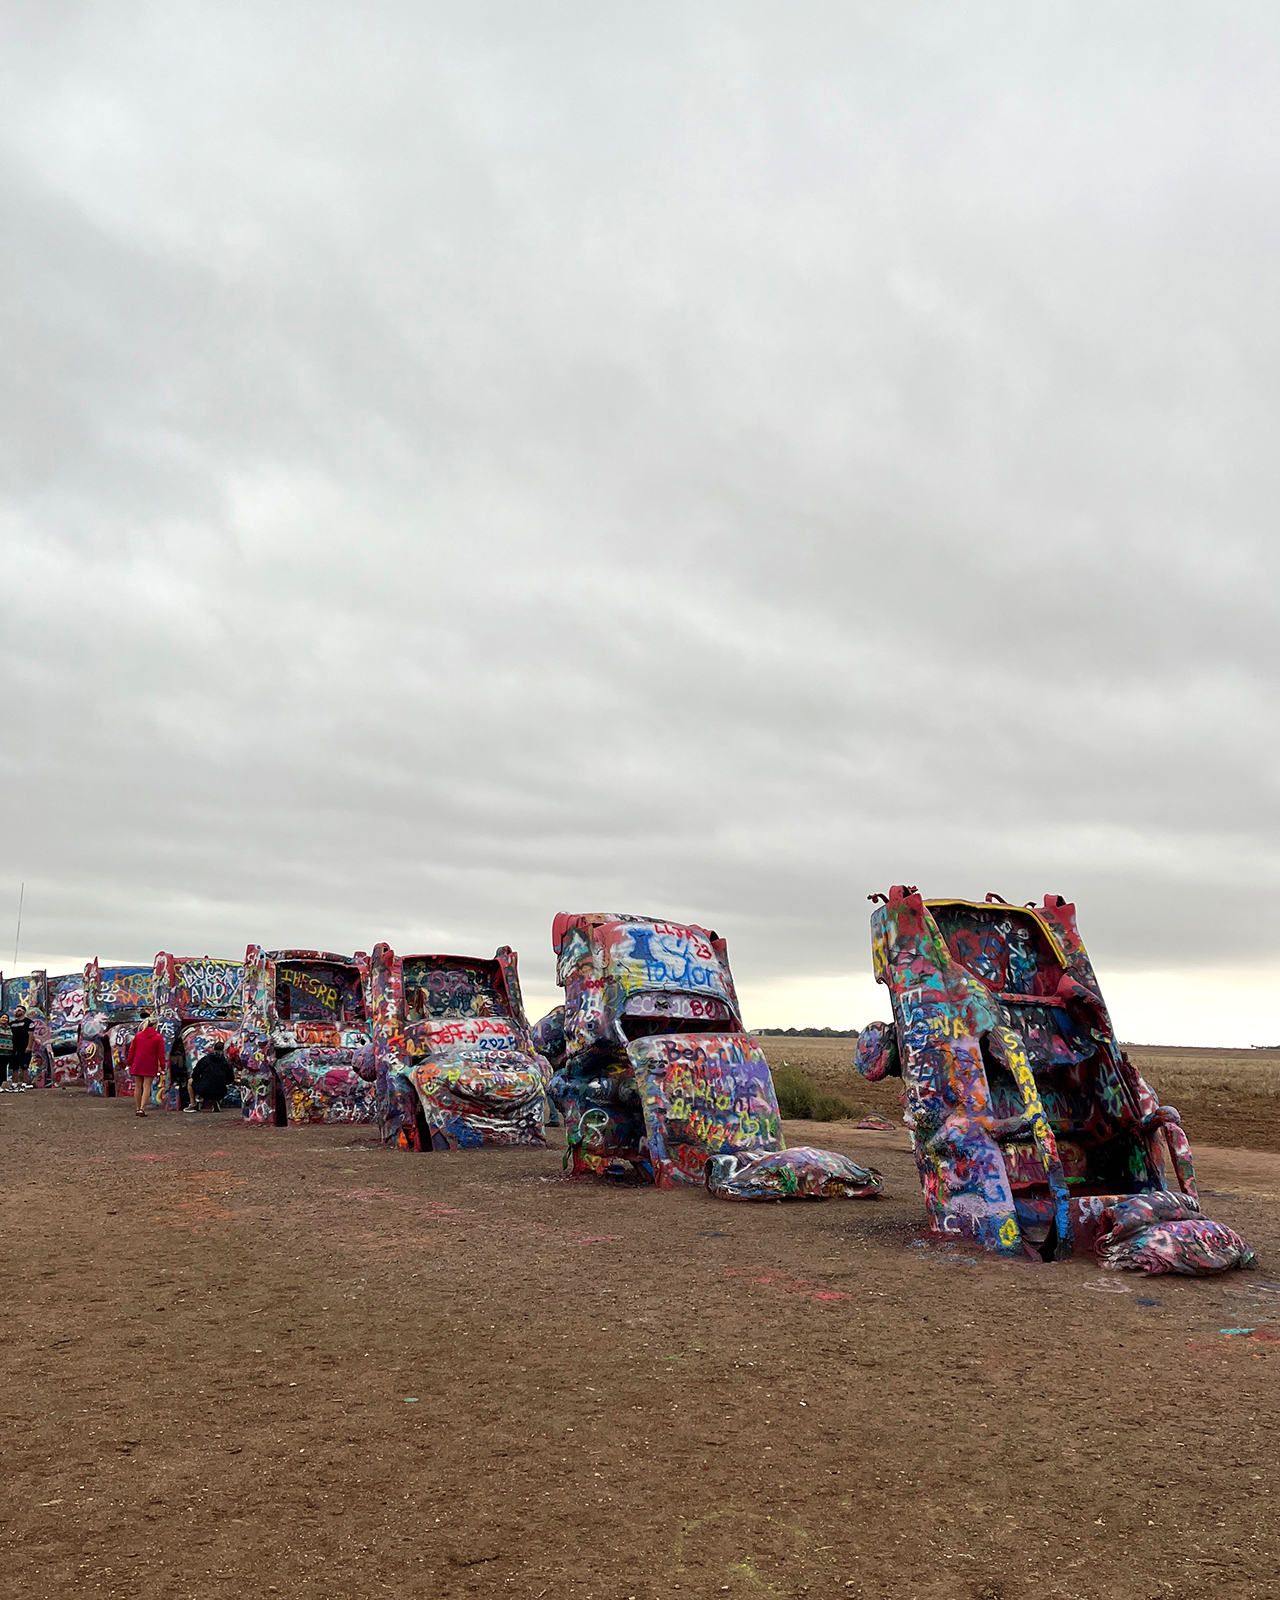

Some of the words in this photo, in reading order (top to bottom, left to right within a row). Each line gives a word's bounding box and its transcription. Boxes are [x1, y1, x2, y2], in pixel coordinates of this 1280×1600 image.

[641, 956, 719, 989] Taylor
[460, 1050, 507, 1059] CHICO
[661, 1040, 707, 1062] Ben
